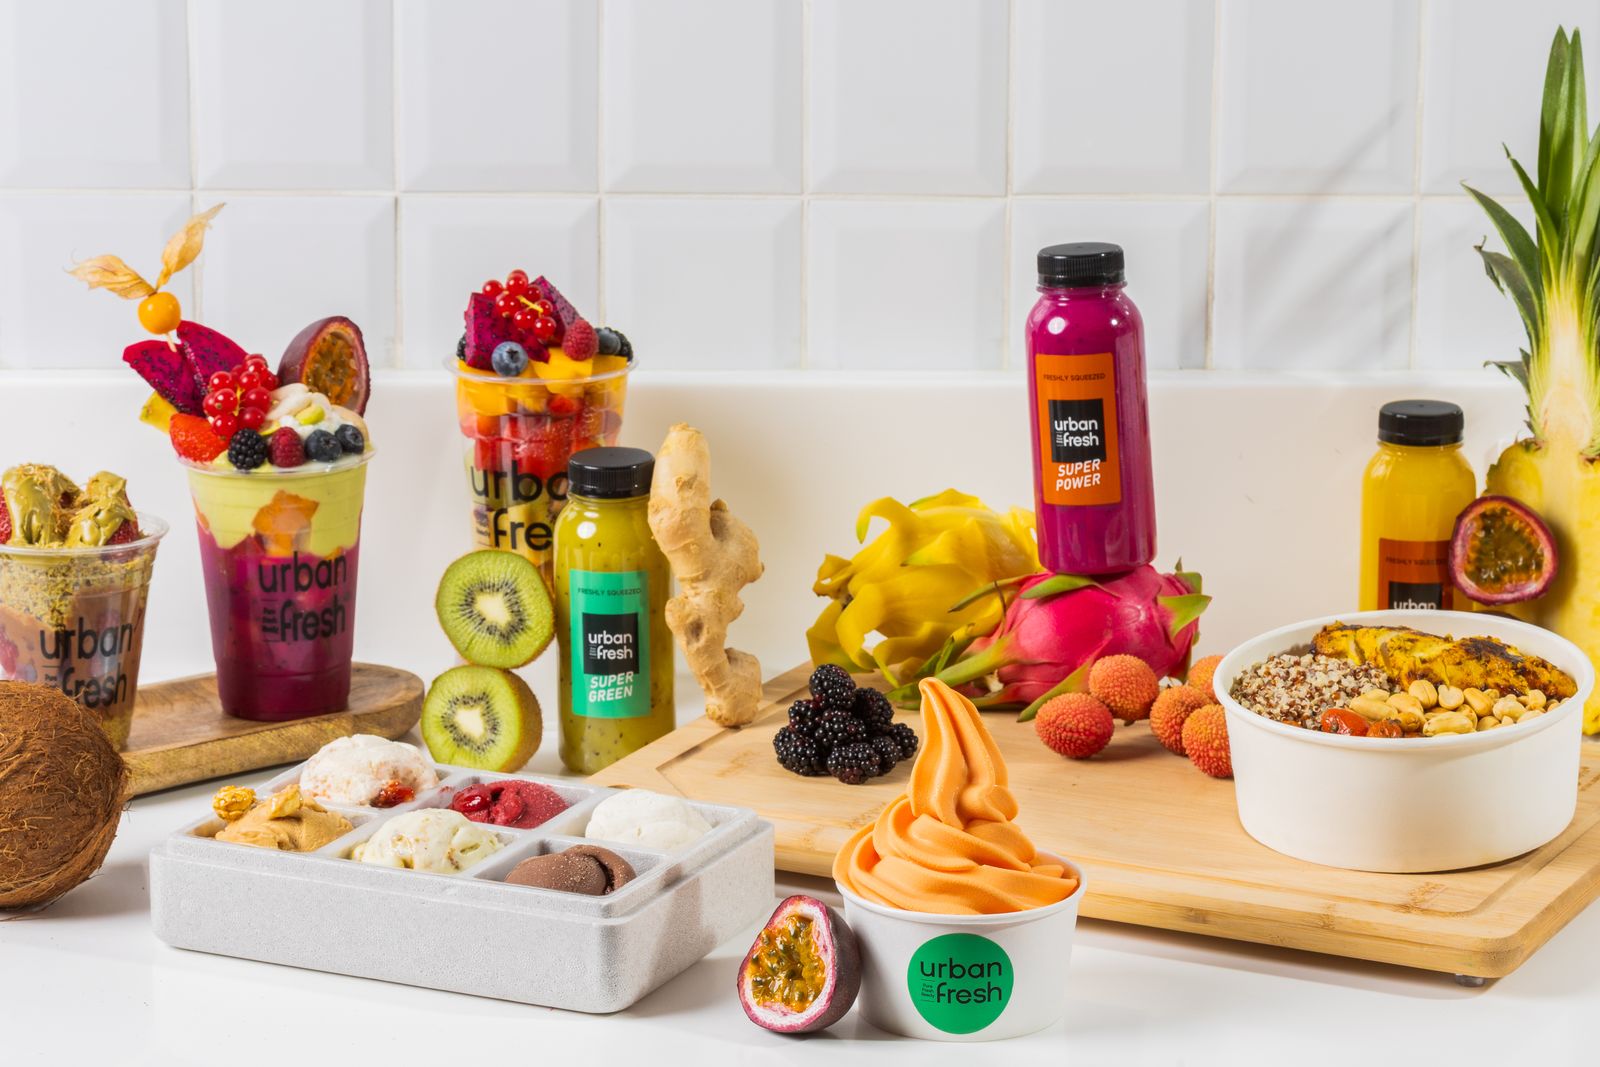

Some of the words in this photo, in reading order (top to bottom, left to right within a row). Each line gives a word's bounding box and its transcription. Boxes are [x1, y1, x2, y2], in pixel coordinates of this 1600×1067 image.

[1043, 374, 1069, 382] FRESHLY
[1071, 372, 1106, 382] SQUEEZED
[1054, 416, 1099, 431] urban
[1063, 432, 1100, 447] fresh
[1058, 458, 1101, 478] SUPER
[471, 459, 569, 502] urba
[1056, 473, 1101, 492] POWER
[493, 507, 553, 551] fre
[258, 550, 347, 593] urban
[1393, 598, 1437, 611] urban
[280, 594, 346, 642] fresh
[40, 616, 133, 660] urban
[588, 630, 633, 645] urban
[597, 645, 633, 660] fresh
[62, 662, 128, 709] fresh
[590, 670, 634, 689] SUPER
[588, 684, 633, 703] GREEN
[920, 957, 1003, 979] urban
[936, 981, 1003, 1004] fresh
